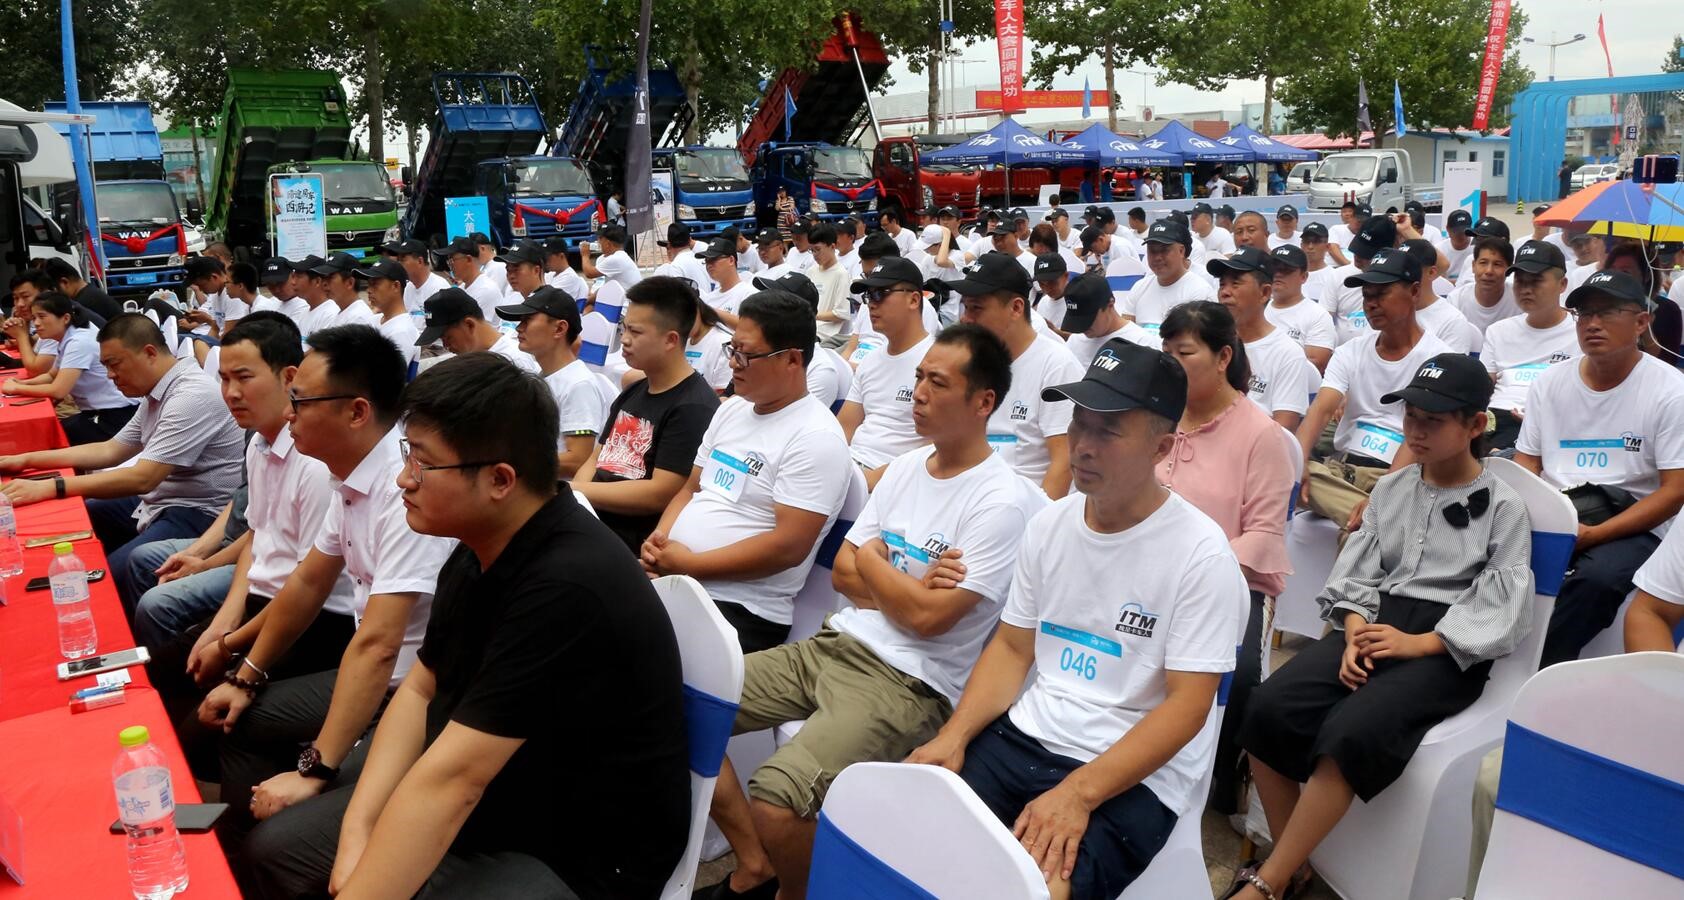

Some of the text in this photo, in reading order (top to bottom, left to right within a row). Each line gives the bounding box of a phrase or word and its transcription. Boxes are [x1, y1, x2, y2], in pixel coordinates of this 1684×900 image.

[118, 230, 151, 239] WAW
[1590, 275, 1613, 285] ITM
[1093, 355, 1120, 371] ITM
[1418, 368, 1444, 379] ITM
[897, 389, 913, 398] ITM
[1361, 434, 1389, 455] 064
[1577, 452, 1608, 468] 070
[714, 468, 735, 491] 002
[925, 538, 950, 553] ITM
[1119, 610, 1157, 630] ITM
[1060, 647, 1097, 681] 046
